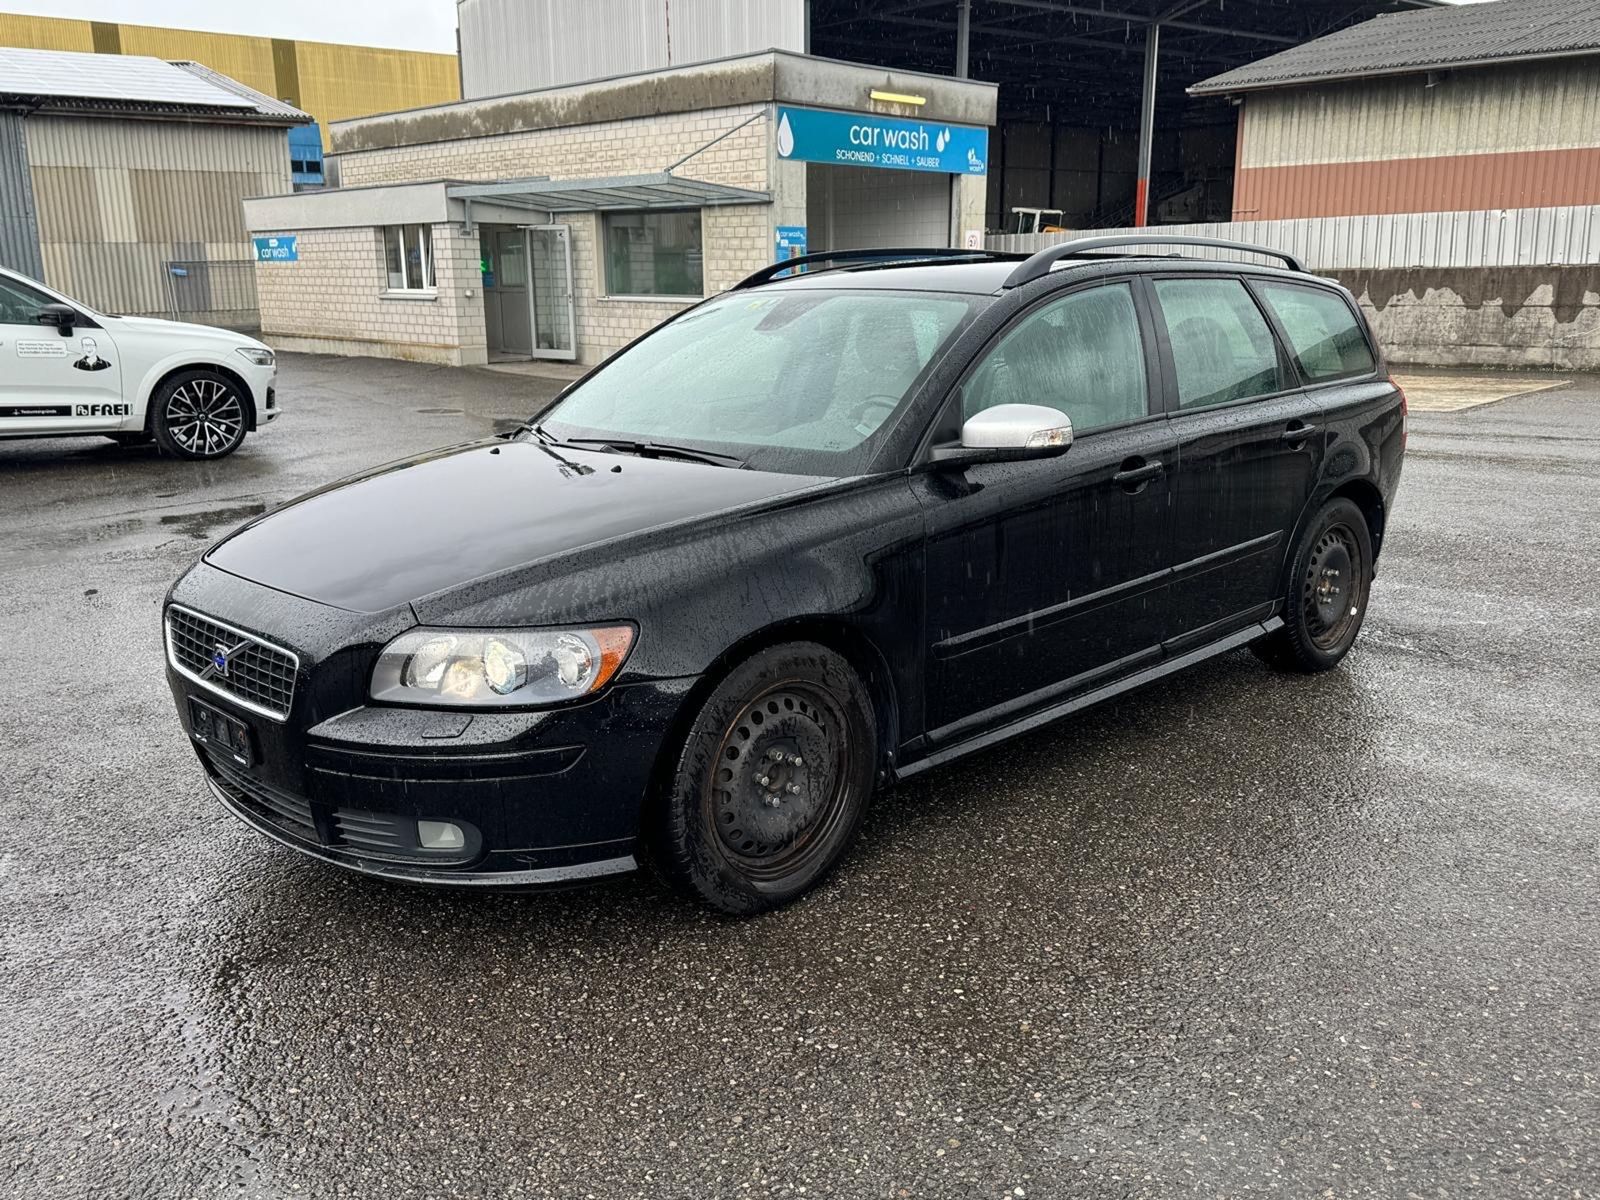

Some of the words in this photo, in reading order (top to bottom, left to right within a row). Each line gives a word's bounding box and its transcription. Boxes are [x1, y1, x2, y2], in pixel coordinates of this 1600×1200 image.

[849, 125, 880, 146] car
[882, 126, 929, 151] wash
[836, 149, 875, 162] SCHONEND
[881, 153, 910, 166] SCHNELL
[916, 156, 940, 168] SAUBER
[91, 404, 129, 416] FREI
